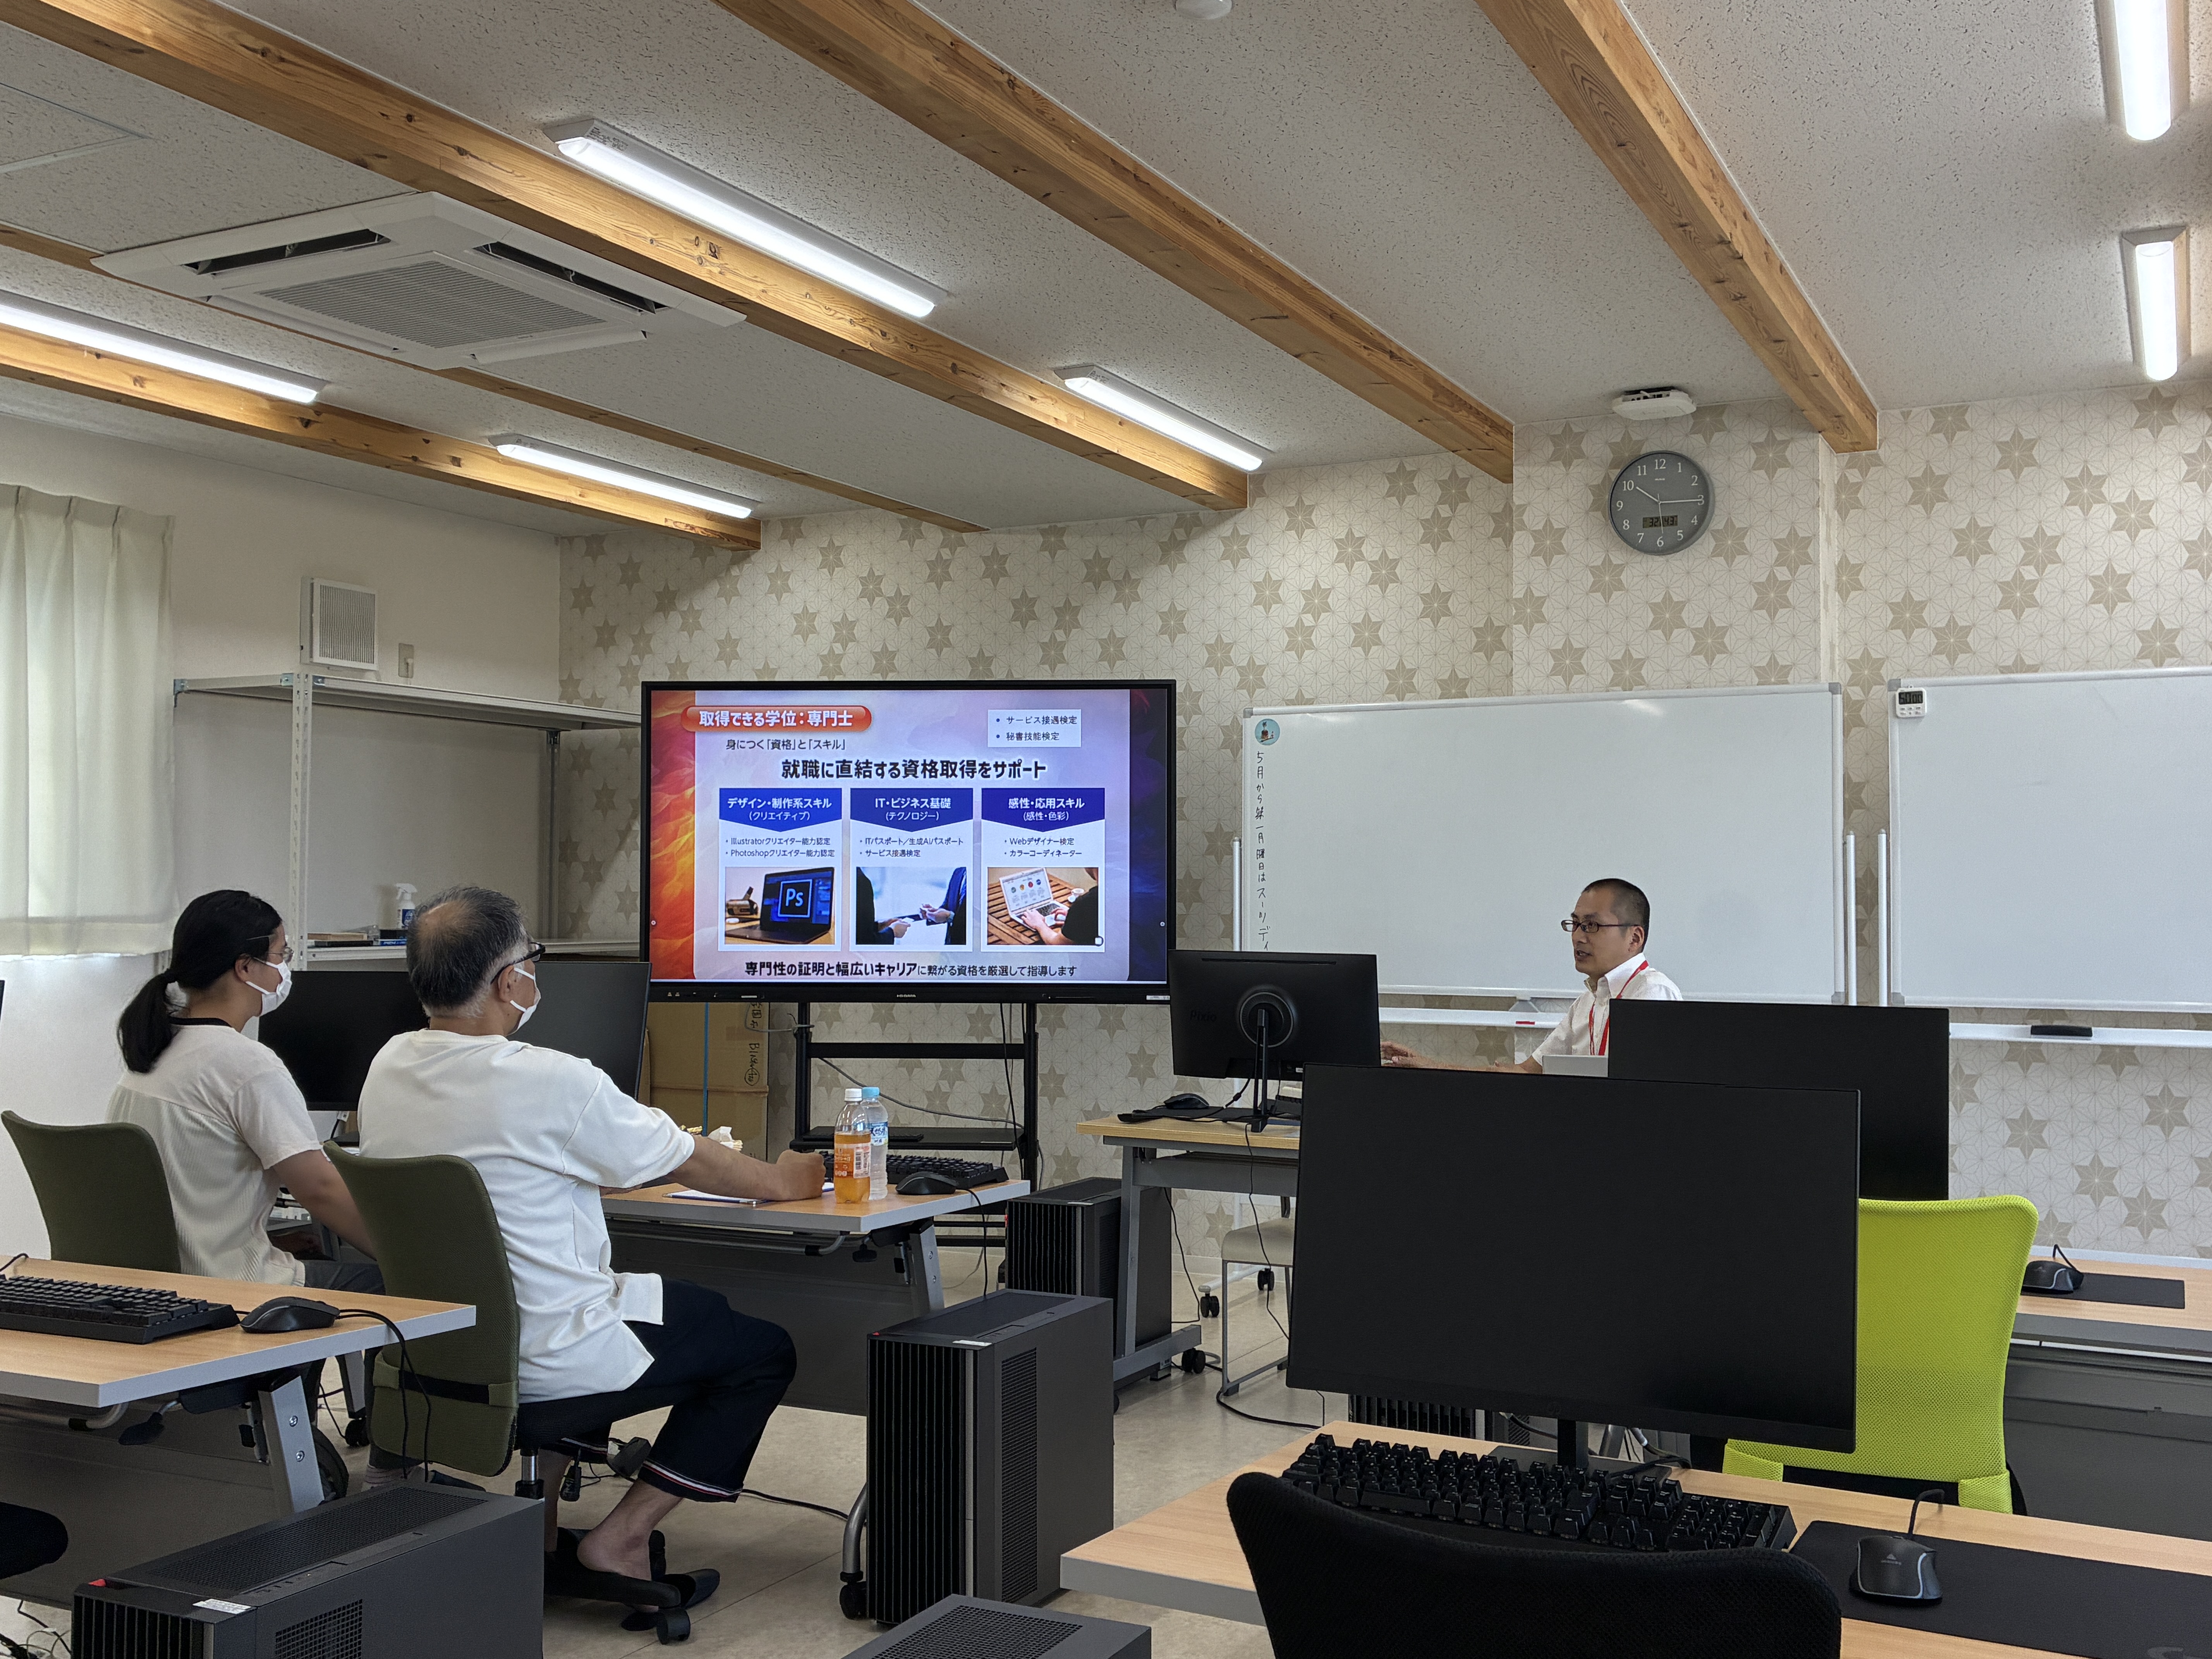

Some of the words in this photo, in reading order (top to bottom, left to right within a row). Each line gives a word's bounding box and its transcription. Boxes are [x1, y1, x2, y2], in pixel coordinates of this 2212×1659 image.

[1654, 459, 1666, 470] 12
[1678, 462, 1682, 473] 1
[1637, 465, 1647, 476] 11
[1623, 480, 1634, 491] 10
[1691, 475, 1698, 486] 2
[1616, 500, 1623, 511] 9
[1697, 495, 1704, 505] 3
[1623, 519, 1630, 530] 8
[1691, 515, 1698, 525] 4
[1637, 533, 1644, 543] 7
[1677, 530, 1683, 541] 5
[1657, 536, 1664, 547] 6
[699, 711, 853, 727] 取得できる学位：専門士
[1006, 715, 1077, 725] サービス接遇検定
[1006, 732, 1060, 741] 秘書技能検定
[726, 739, 846, 750] 身につく「資格」と「スキル」
[781, 758, 1046, 779] 就職に直結する資格取得をサポート
[727, 797, 832, 809] デザイン・制作系スキル
[875, 797, 951, 809] IT・ビジネス基礎
[1008, 797, 1085, 809] 感性・応用スキル
[730, 837, 830, 845] Illustratorクリエイター能力認定
[1010, 837, 1074, 845] Webデザイナー検定
[730, 849, 835, 858] Photoshopクリエイター能力認定
[865, 849, 921, 857] サービス接遇検定
[1010, 849, 1082, 857] カラーコーディネーター
[785, 888, 804, 907] Ps
